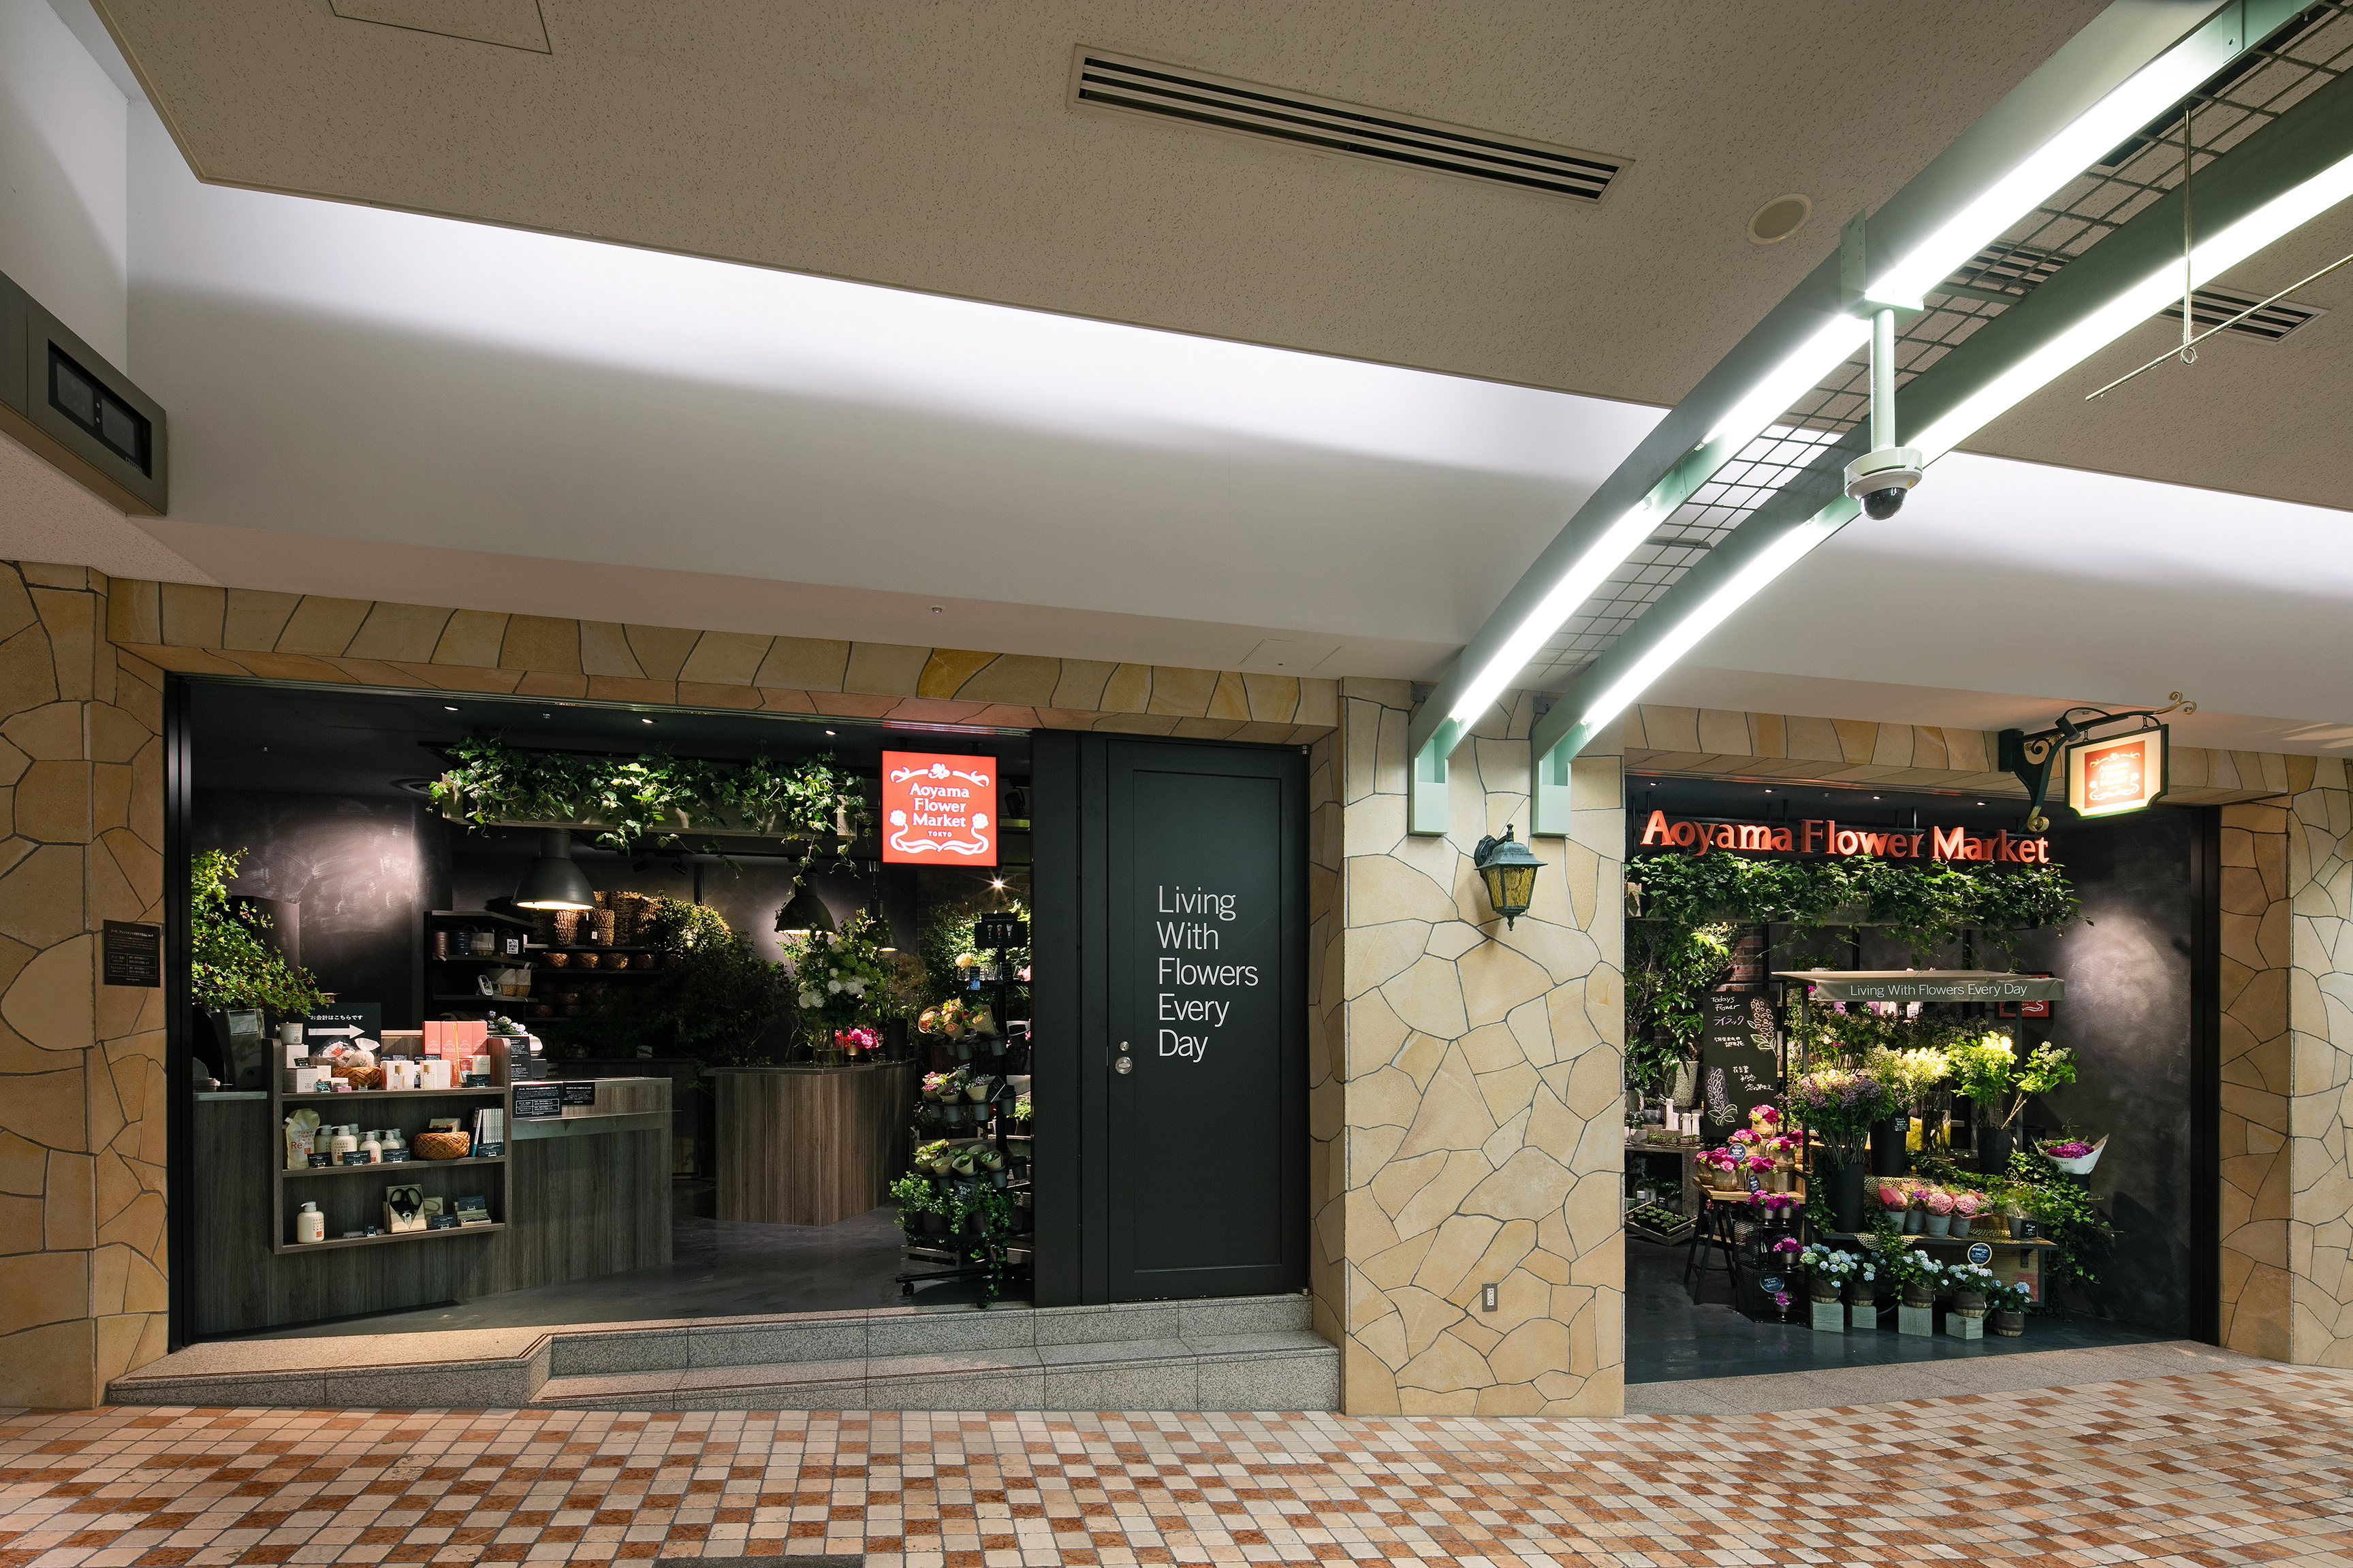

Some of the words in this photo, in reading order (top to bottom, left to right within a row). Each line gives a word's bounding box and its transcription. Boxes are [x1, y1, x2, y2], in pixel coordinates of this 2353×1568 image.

[909, 782, 970, 799] Aoyama
[913, 797, 966, 812] Flower
[913, 812, 966, 827] Market
[1640, 810, 1795, 857] Aoyama
[1798, 819, 1924, 857] Flower
[1929, 826, 2049, 863] Market
[1159, 885, 1236, 921] Living
[1156, 921, 1218, 950] With
[1159, 957, 1259, 986] Flowers
[1850, 985, 1884, 997] Living
[1887, 985, 1915, 995] With
[1919, 985, 1964, 995] Flowers
[1968, 984, 2001, 997] Every
[2004, 983, 2027, 997] Day
[1710, 995, 1735, 1004] Todays
[1159, 993, 1230, 1027] Every
[1715, 1004, 1740, 1012] Flower
[1713, 1015, 1744, 1026] ライラック
[1159, 1029, 1208, 1063] Day
[291, 1141, 302, 1149] Re
